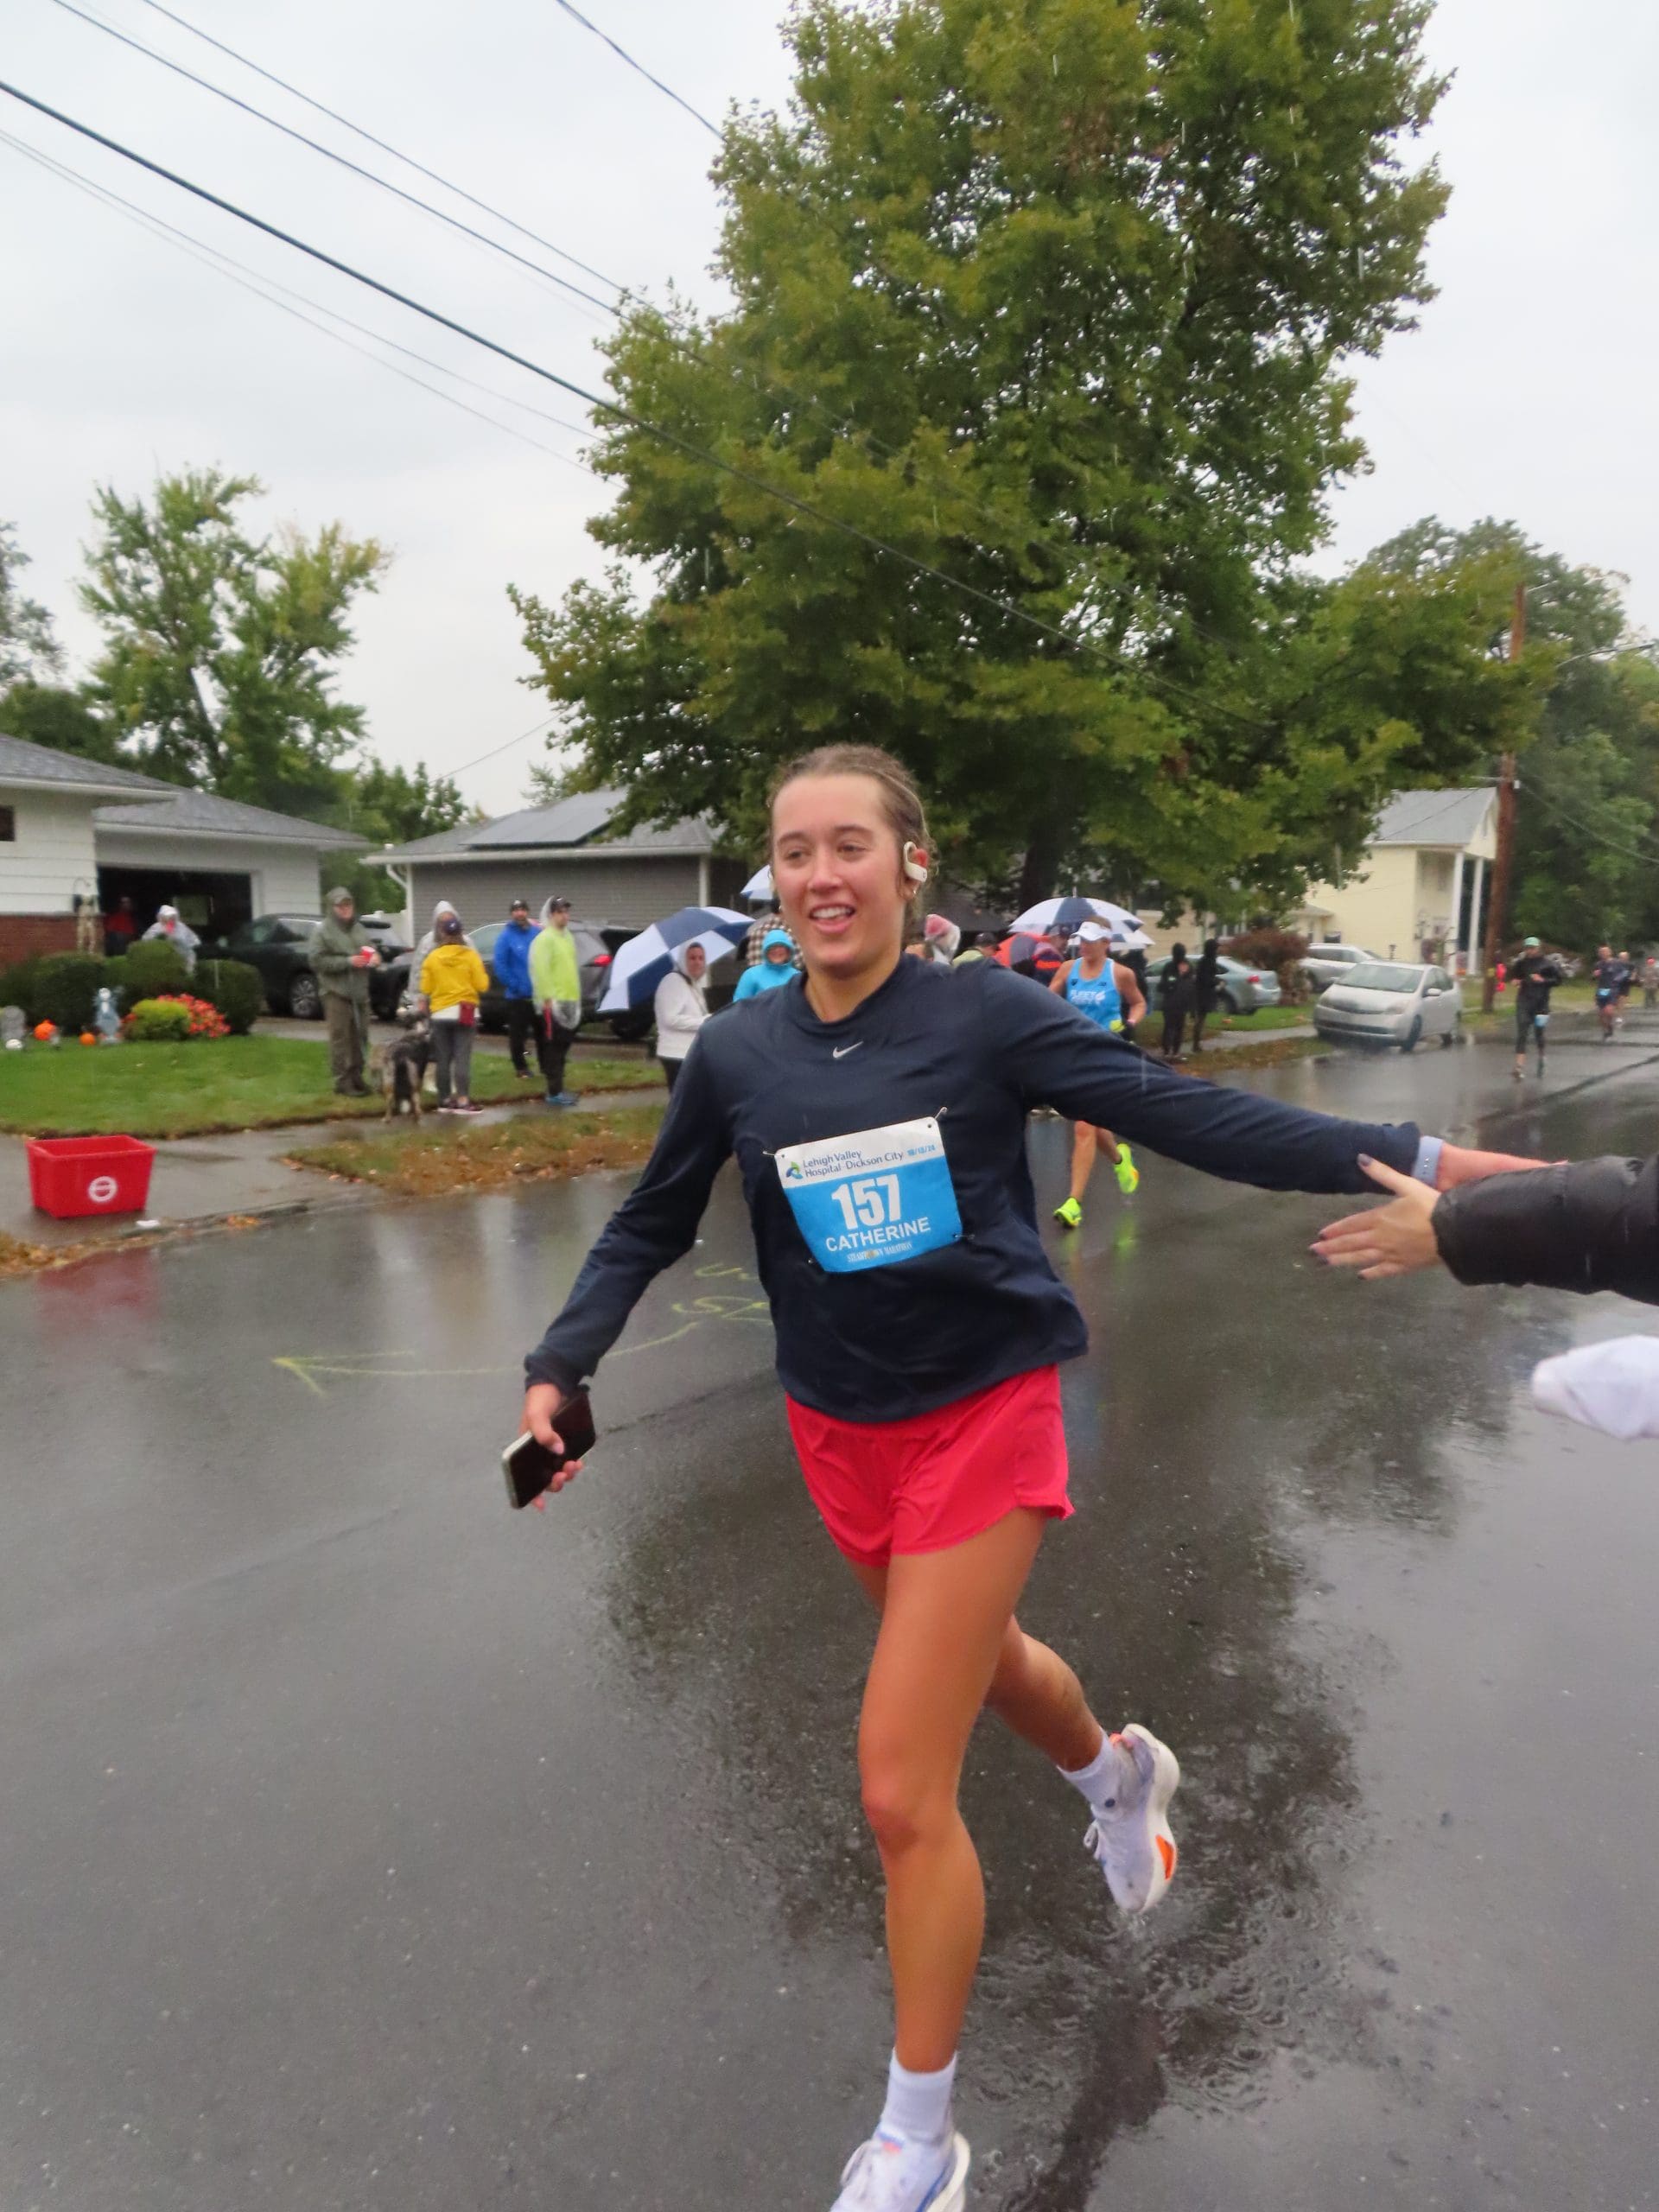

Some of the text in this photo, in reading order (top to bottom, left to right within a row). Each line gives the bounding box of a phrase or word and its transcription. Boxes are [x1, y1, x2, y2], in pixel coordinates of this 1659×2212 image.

[803, 1150, 861, 1167] Lehigh Valley
[804, 1152, 904, 1178] Hospital Dickson City
[831, 1173, 901, 1230] 157
[825, 1217, 931, 1252] CATHERINE
